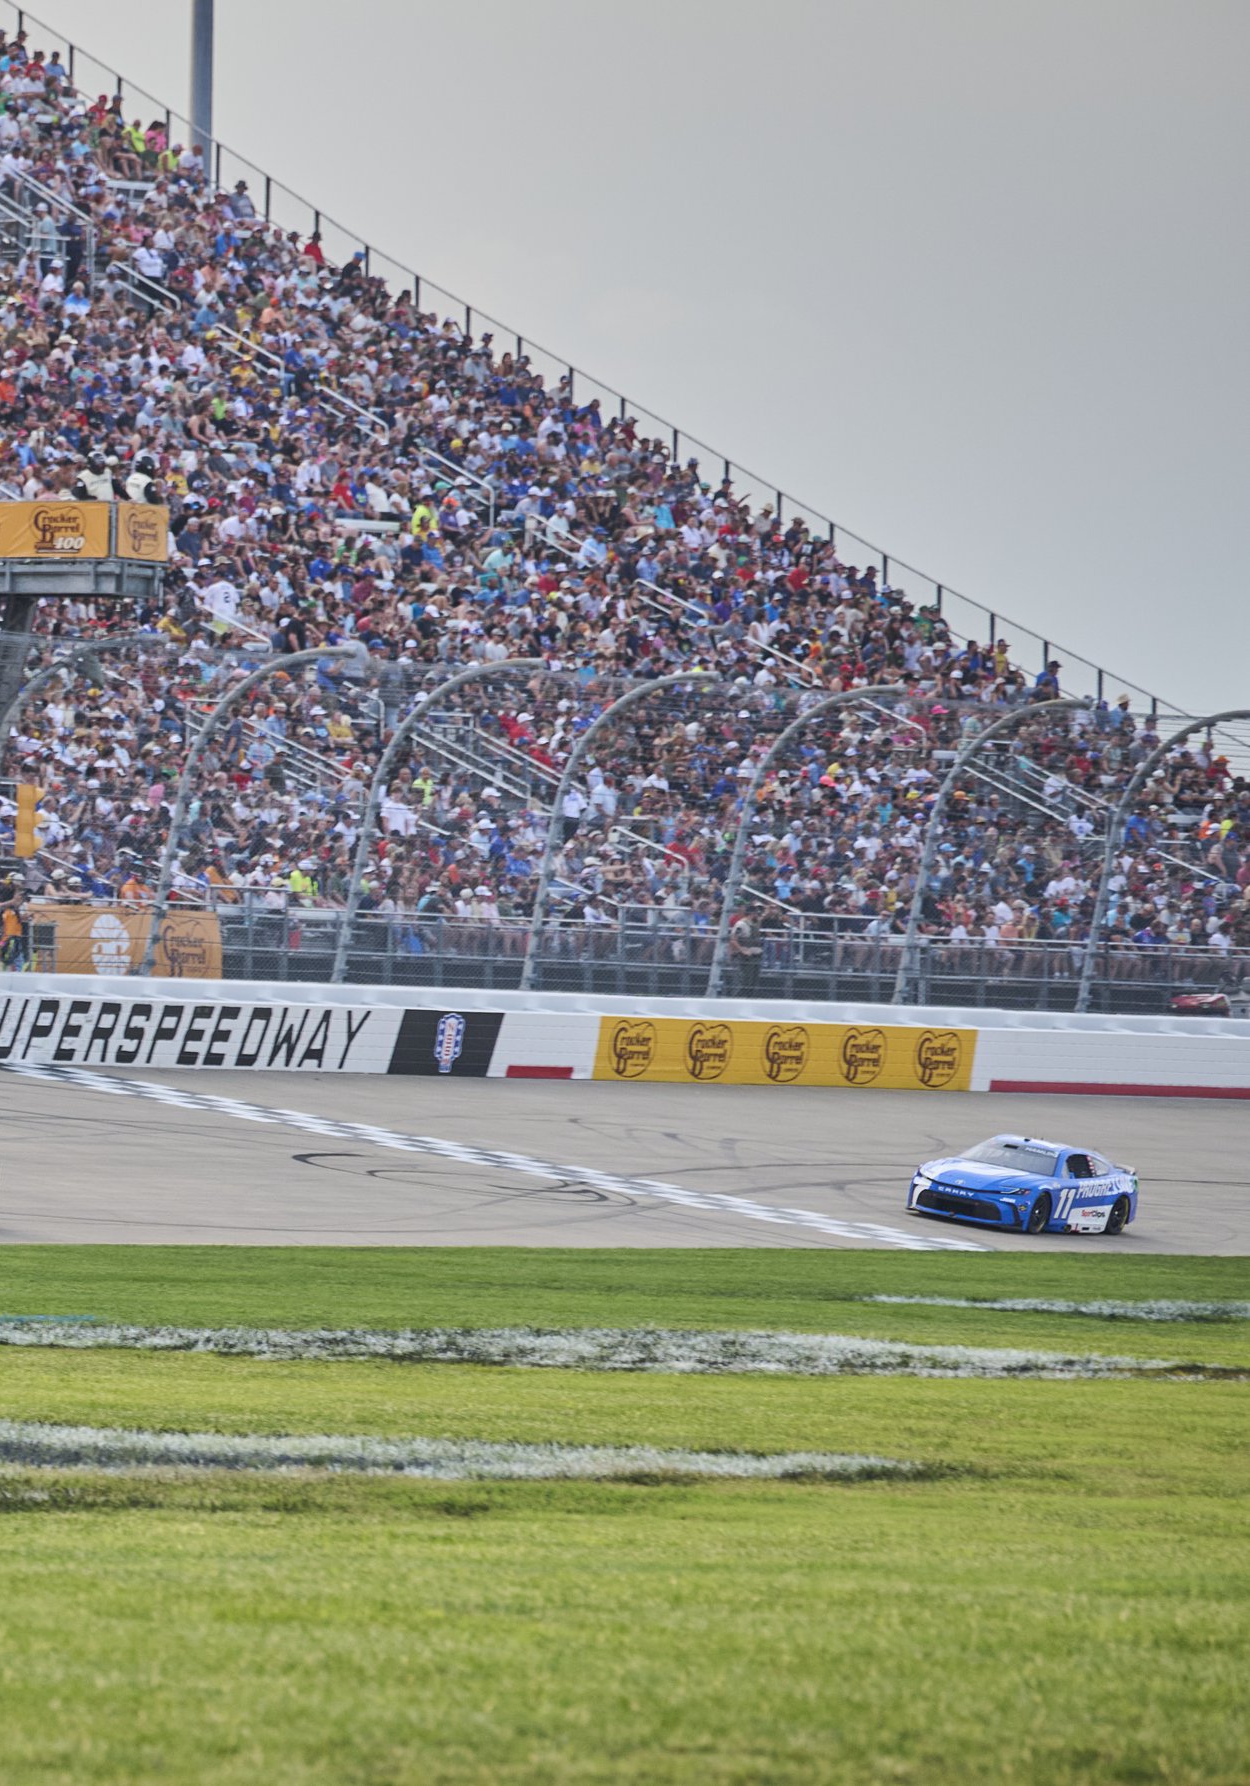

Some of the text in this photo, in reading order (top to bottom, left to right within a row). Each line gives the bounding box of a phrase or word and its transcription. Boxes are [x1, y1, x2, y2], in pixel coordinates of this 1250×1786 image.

[34, 510, 79, 532] Cracker
[41, 524, 79, 543] Barrel
[54, 537, 85, 549] 400
[613, 1027, 651, 1057] Cracker
[689, 1030, 728, 1060] Cracker
[766, 1032, 804, 1062] Cracker
[843, 1035, 882, 1065] Cracker
[918, 1038, 956, 1068] Cracker
[1053, 1188, 1077, 1219] 11
